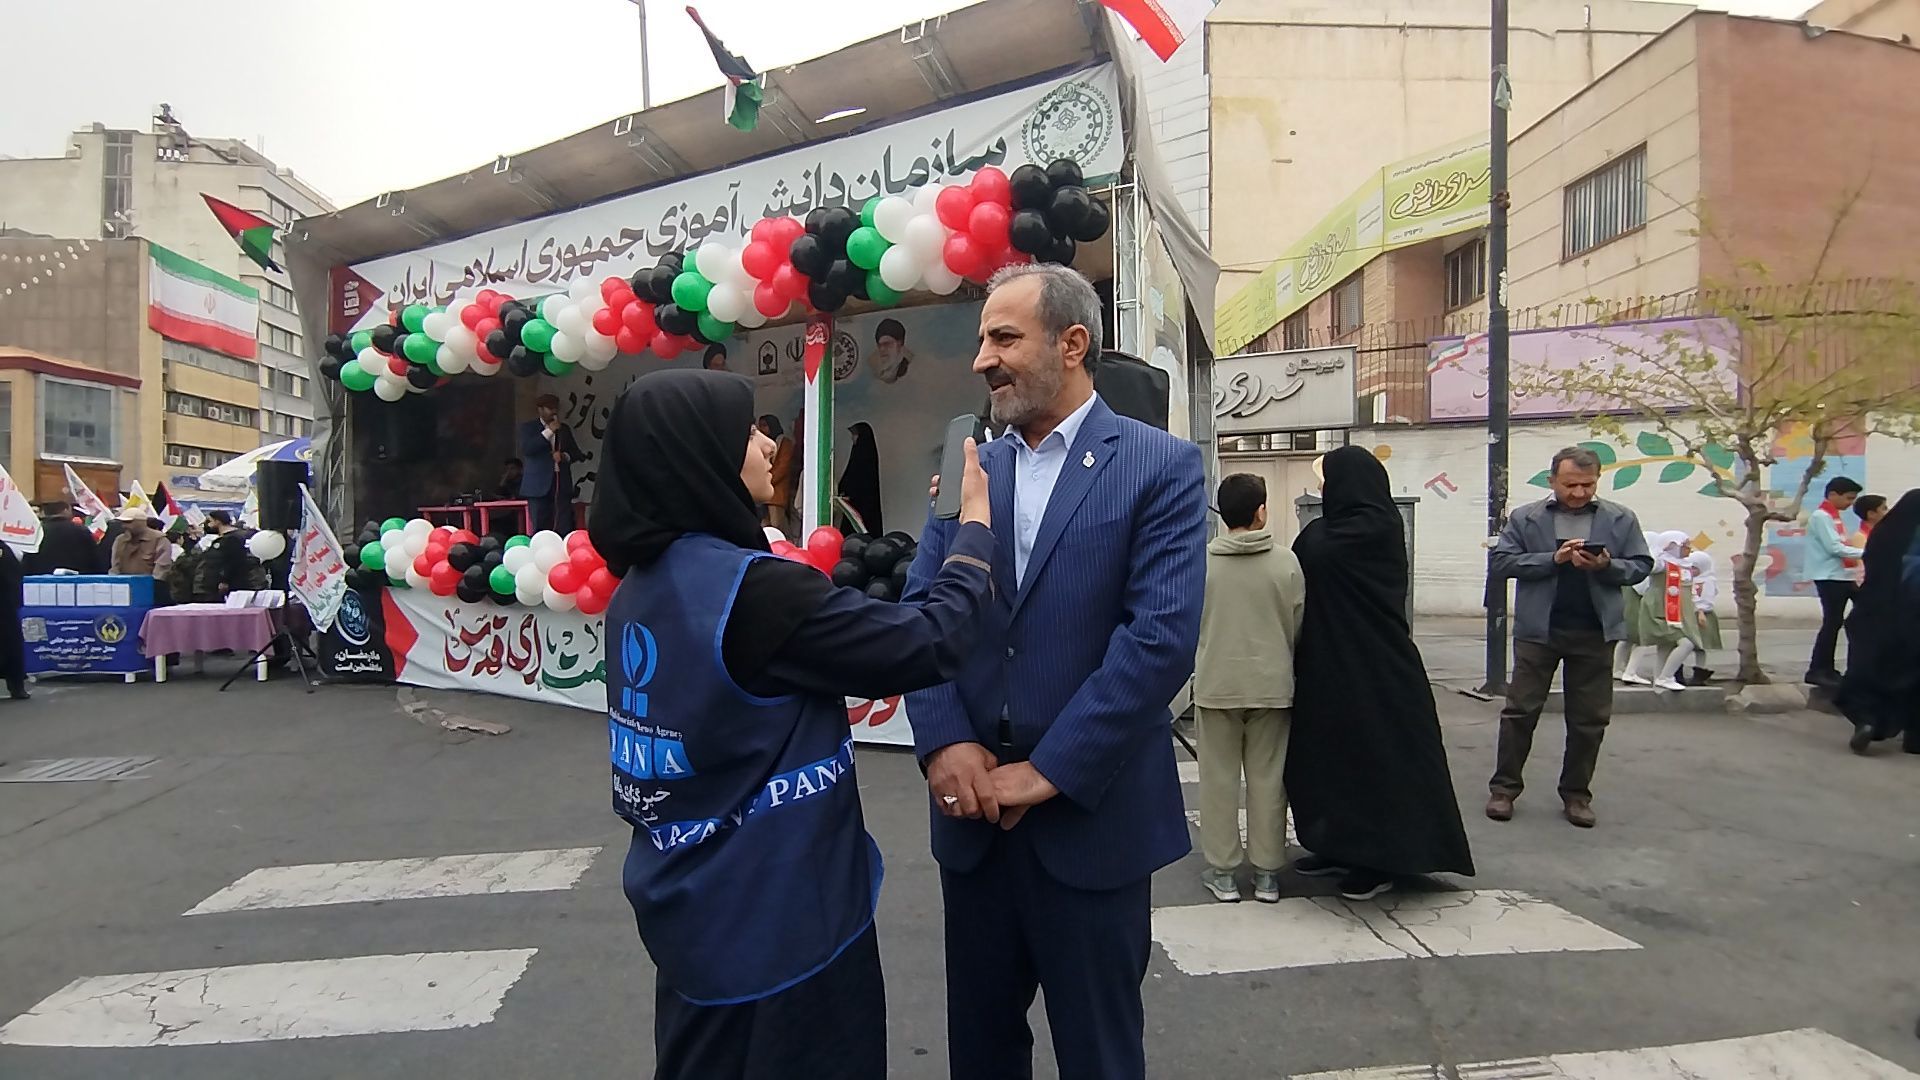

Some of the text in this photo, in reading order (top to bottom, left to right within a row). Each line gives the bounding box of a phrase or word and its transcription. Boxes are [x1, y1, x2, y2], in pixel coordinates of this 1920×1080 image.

[741, 161, 847, 235] دانش
[856, 128, 1007, 203] سازمان
[645, 181, 741, 256] آموزی
[387, 259, 434, 312] ایران
[434, 238, 527, 306] اسلامی
[526, 225, 644, 284] جمهوری
